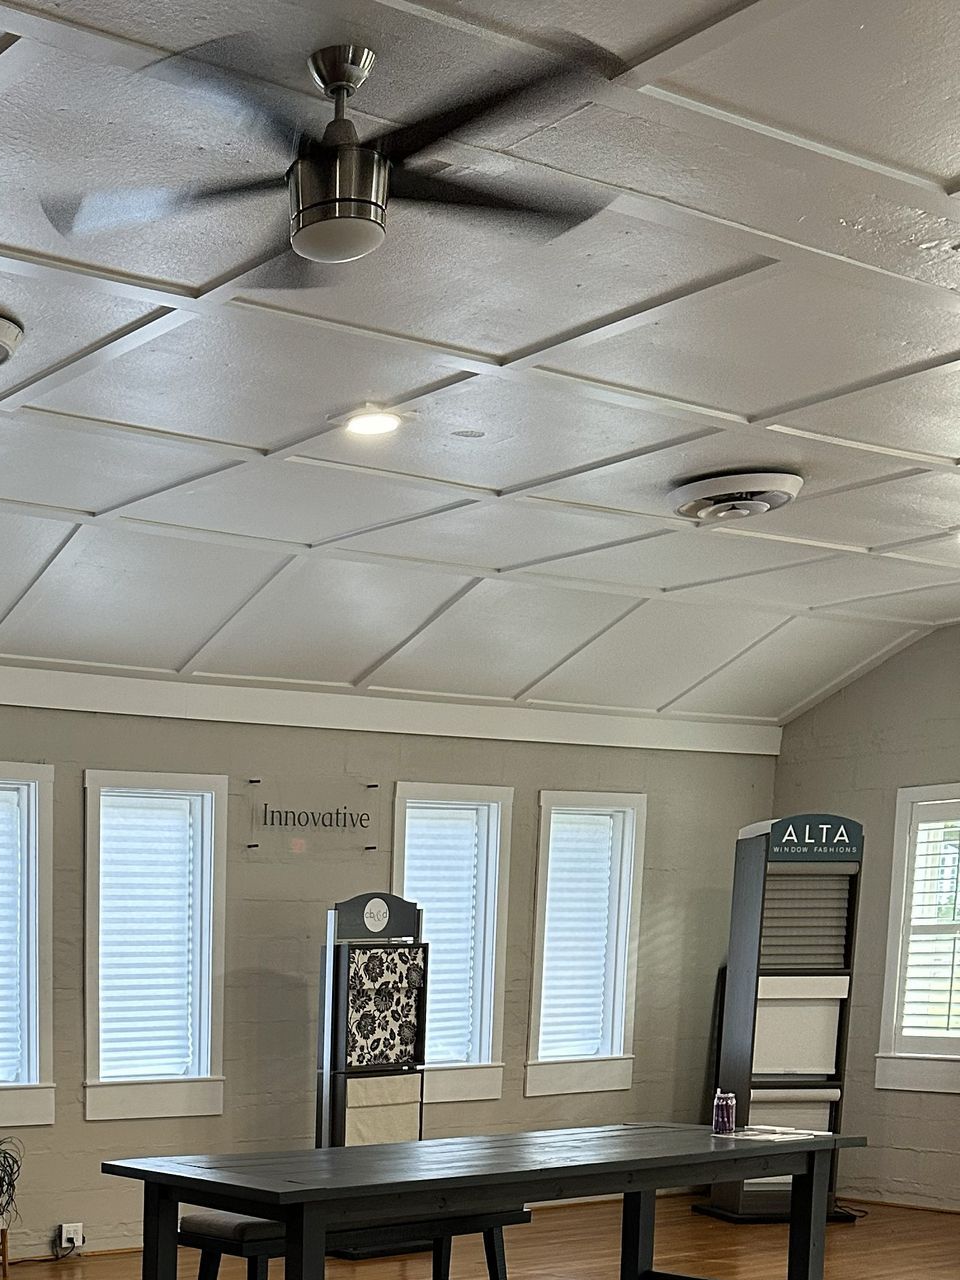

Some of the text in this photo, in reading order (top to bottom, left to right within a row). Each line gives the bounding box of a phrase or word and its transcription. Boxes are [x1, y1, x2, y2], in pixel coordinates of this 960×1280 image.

[262, 803, 370, 829] Innovative
[781, 824, 850, 844] ALTA
[773, 846, 858, 854] WINDOW FASHIONS
